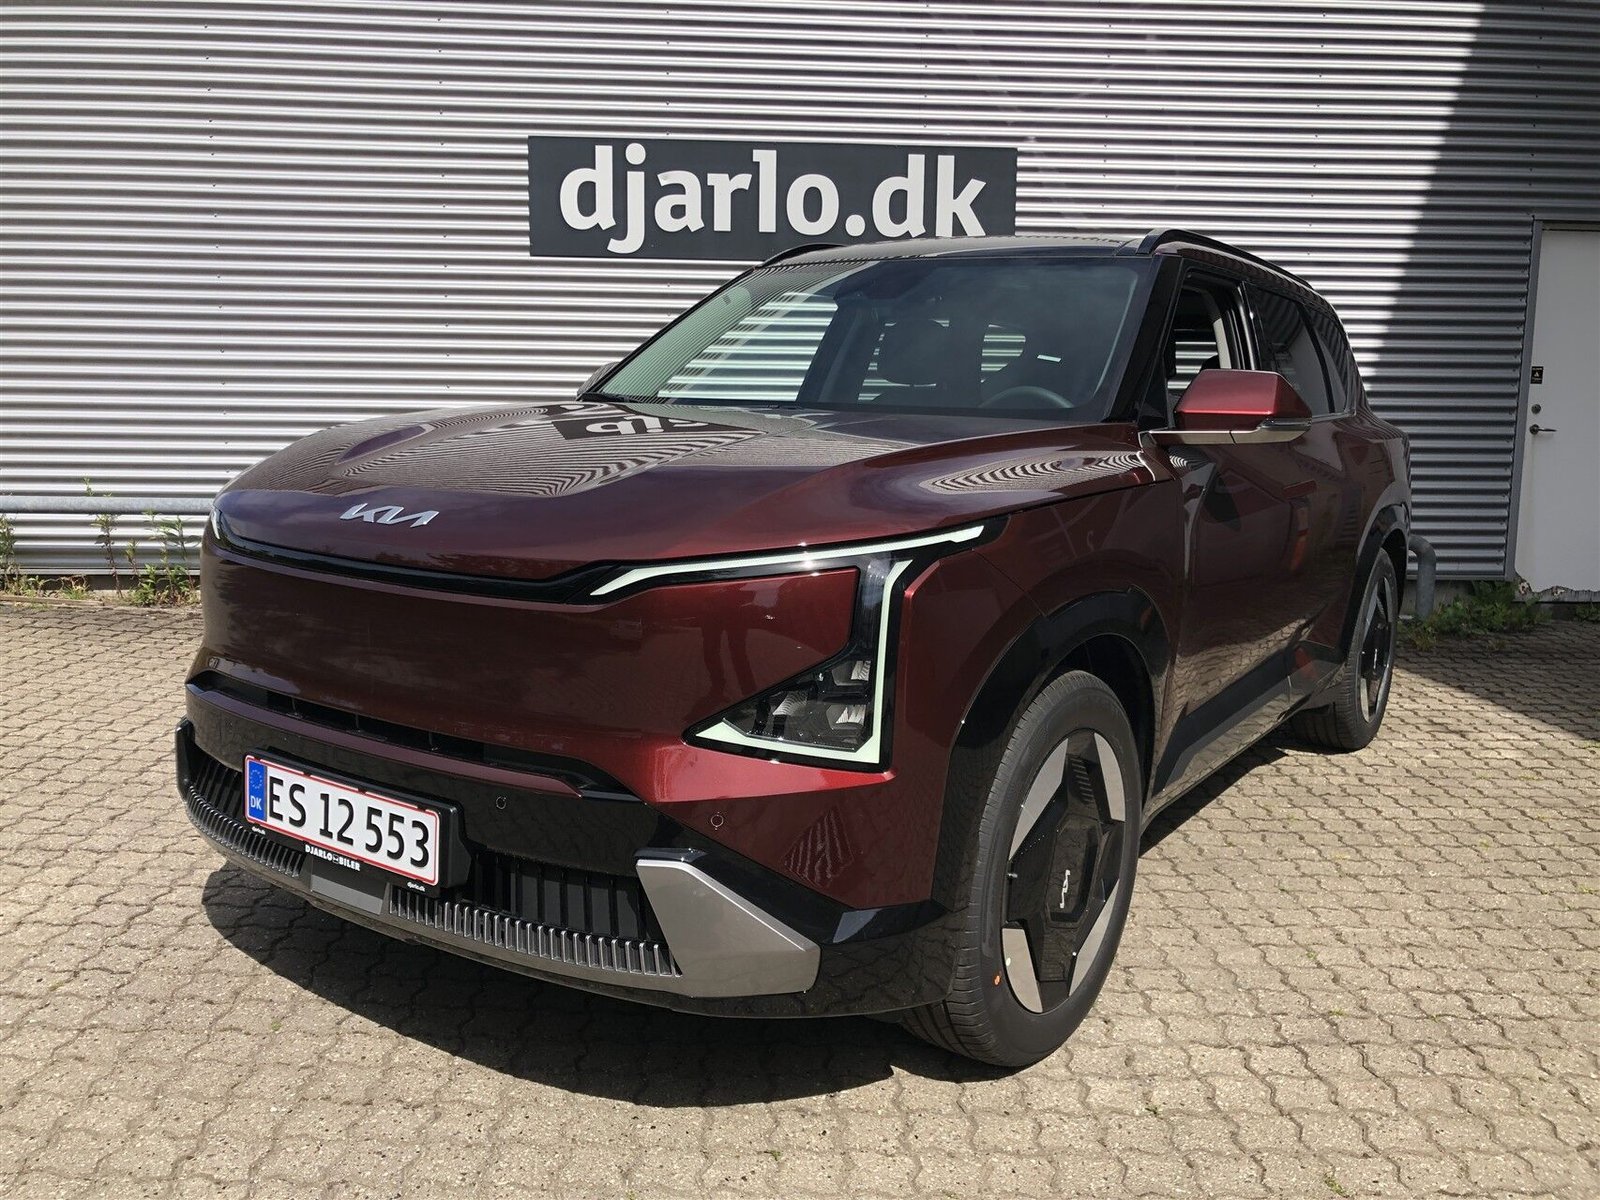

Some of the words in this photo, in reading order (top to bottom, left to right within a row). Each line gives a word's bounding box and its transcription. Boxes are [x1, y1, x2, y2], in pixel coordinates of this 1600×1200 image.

[559, 142, 987, 254] djarlo.dk
[340, 502, 439, 528] KIA
[250, 795, 262, 811] DK
[269, 776, 307, 828] ES
[319, 792, 355, 846] 12
[365, 805, 430, 868] 553
[305, 844, 333, 861] DJARLO
[339, 856, 361, 871] BILER
